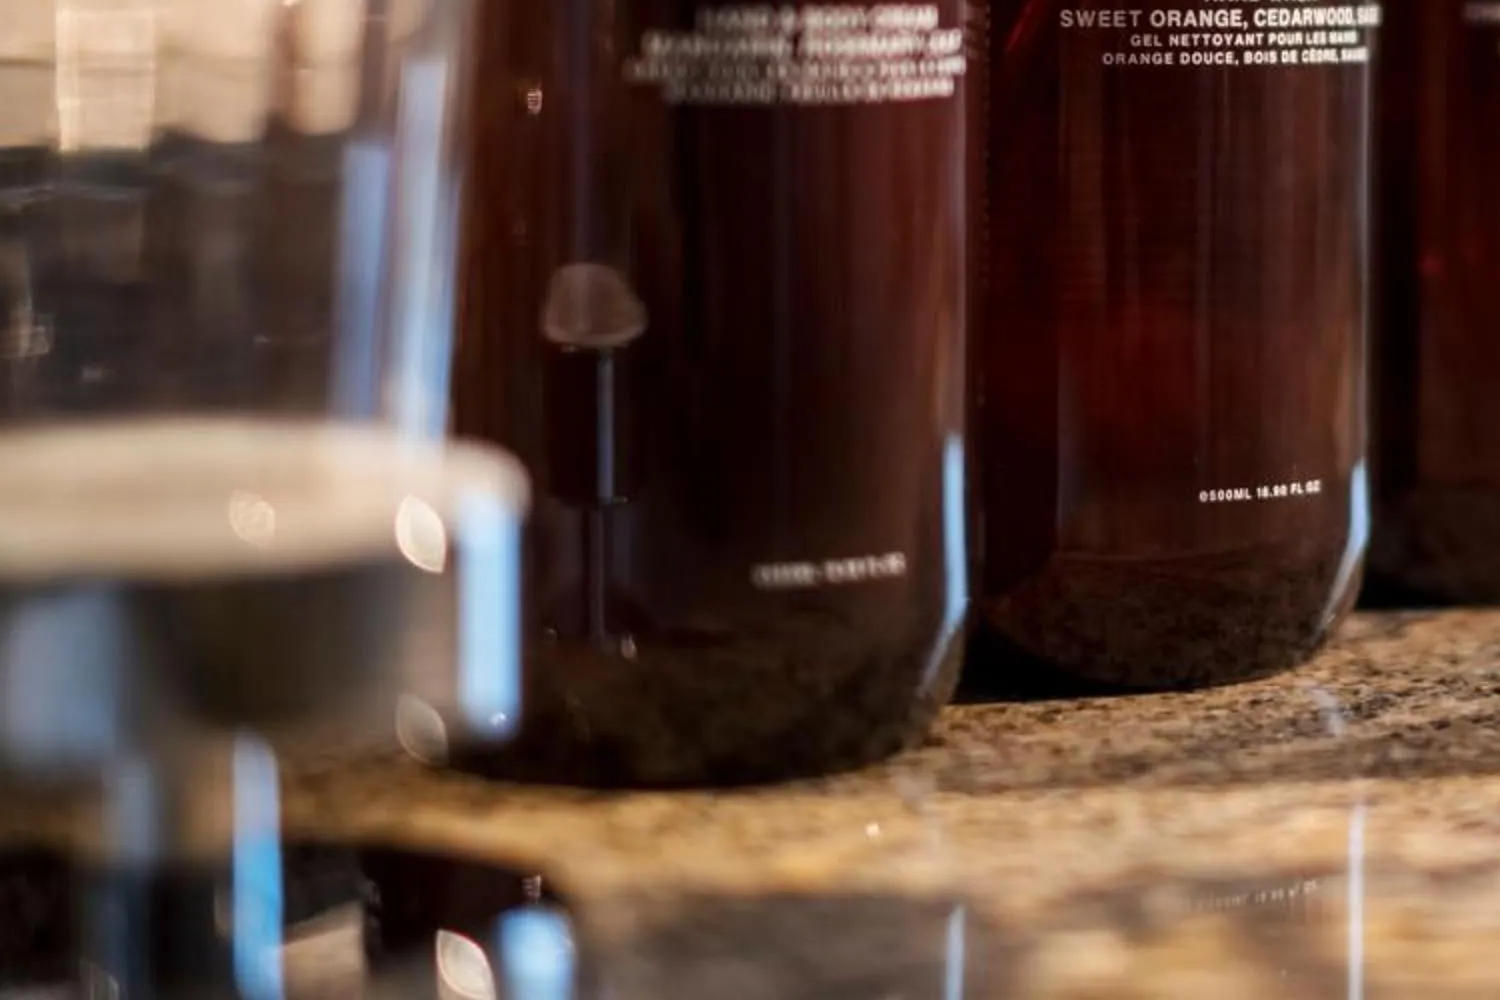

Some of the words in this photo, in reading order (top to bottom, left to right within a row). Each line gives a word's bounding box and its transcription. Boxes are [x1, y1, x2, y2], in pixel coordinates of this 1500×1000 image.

[1060, 10, 1143, 28] SWEET
[1150, 10, 1249, 30] ORANGE,
[1254, 7, 1356, 27] CEDARWOOD,
[1130, 34, 1163, 47] GEL
[1169, 33, 1264, 47] NETTOYANT
[1267, 32, 1303, 46] POUR
[1103, 53, 1174, 65] ORANGE
[1179, 52, 1239, 65] DOUCE,
[1244, 51, 1277, 65] BOIS
[1281, 51, 1298, 64] DE
